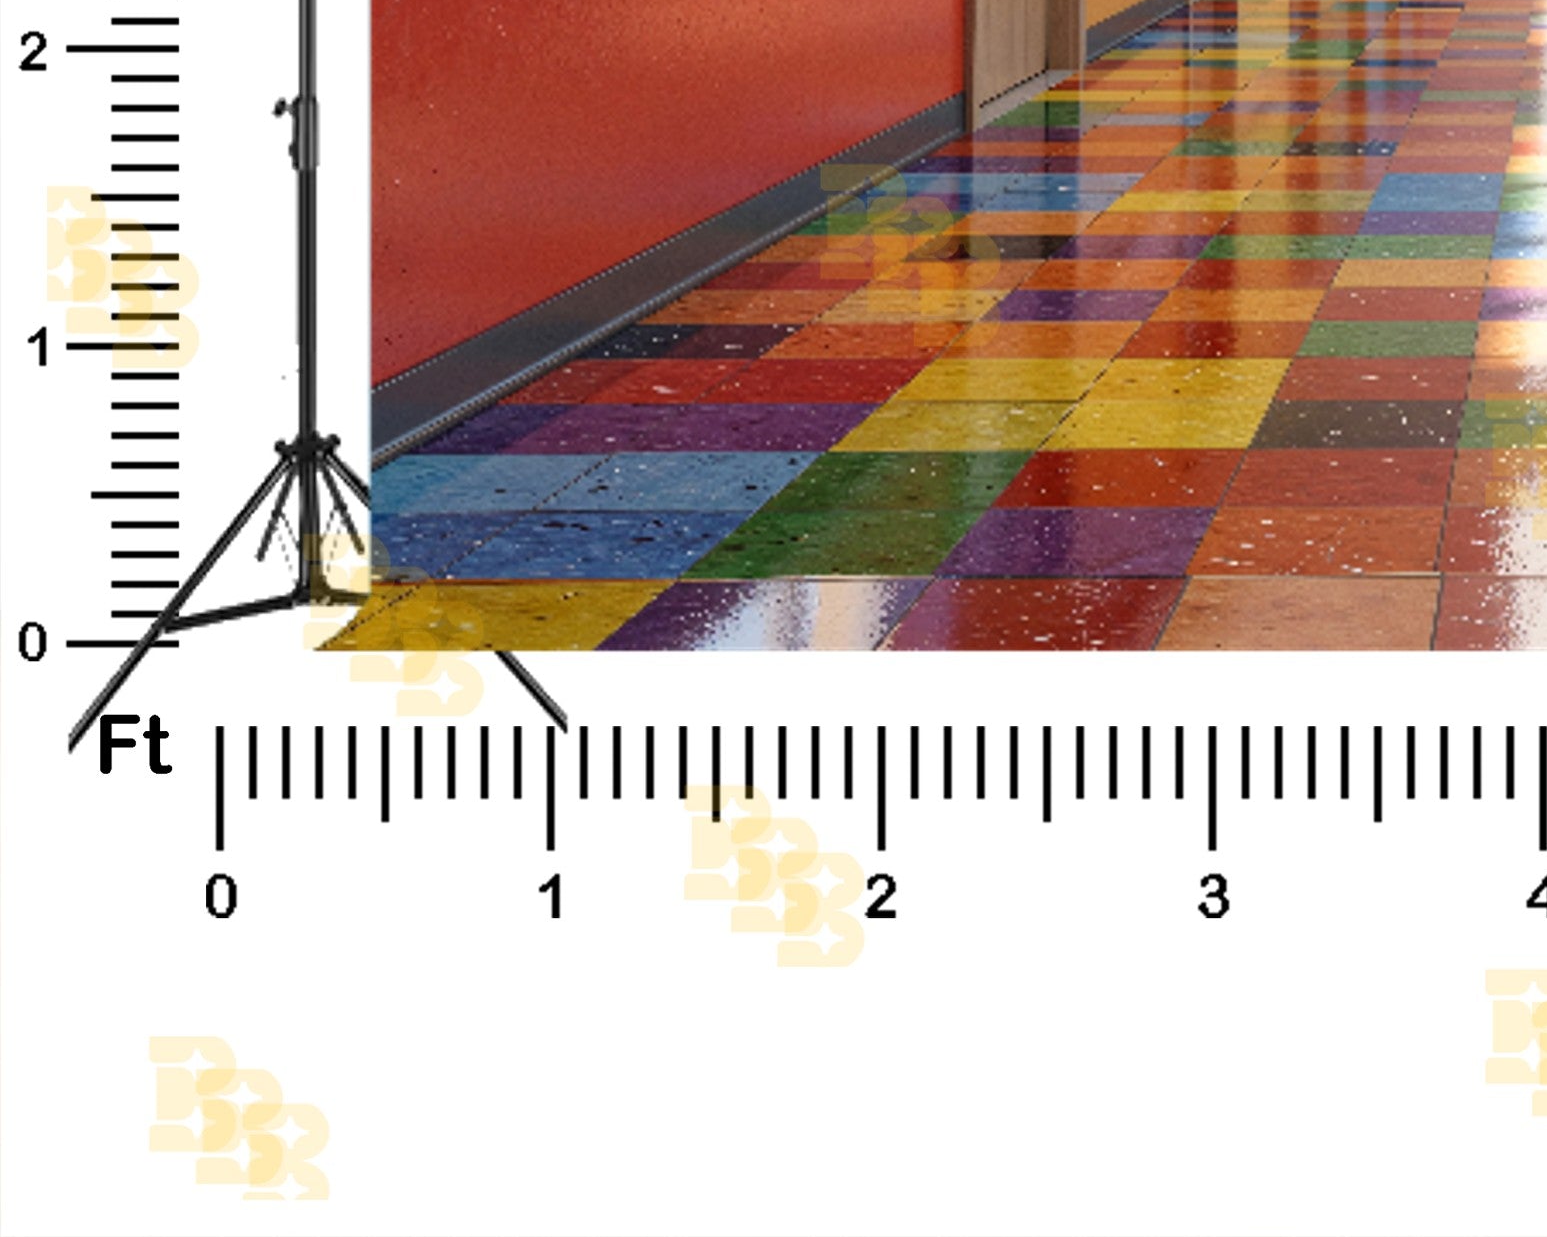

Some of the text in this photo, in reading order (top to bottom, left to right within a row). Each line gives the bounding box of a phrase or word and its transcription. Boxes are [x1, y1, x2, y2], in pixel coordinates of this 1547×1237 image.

[15, 32, 47, 72] 2
[27, 327, 47, 367] 1
[18, 622, 47, 662] 0
[100, 715, 173, 775] Ft
[206, 874, 237, 918] 0
[538, 874, 561, 918] 1
[865, 874, 897, 918] 2
[1198, 874, 1230, 918] 3
